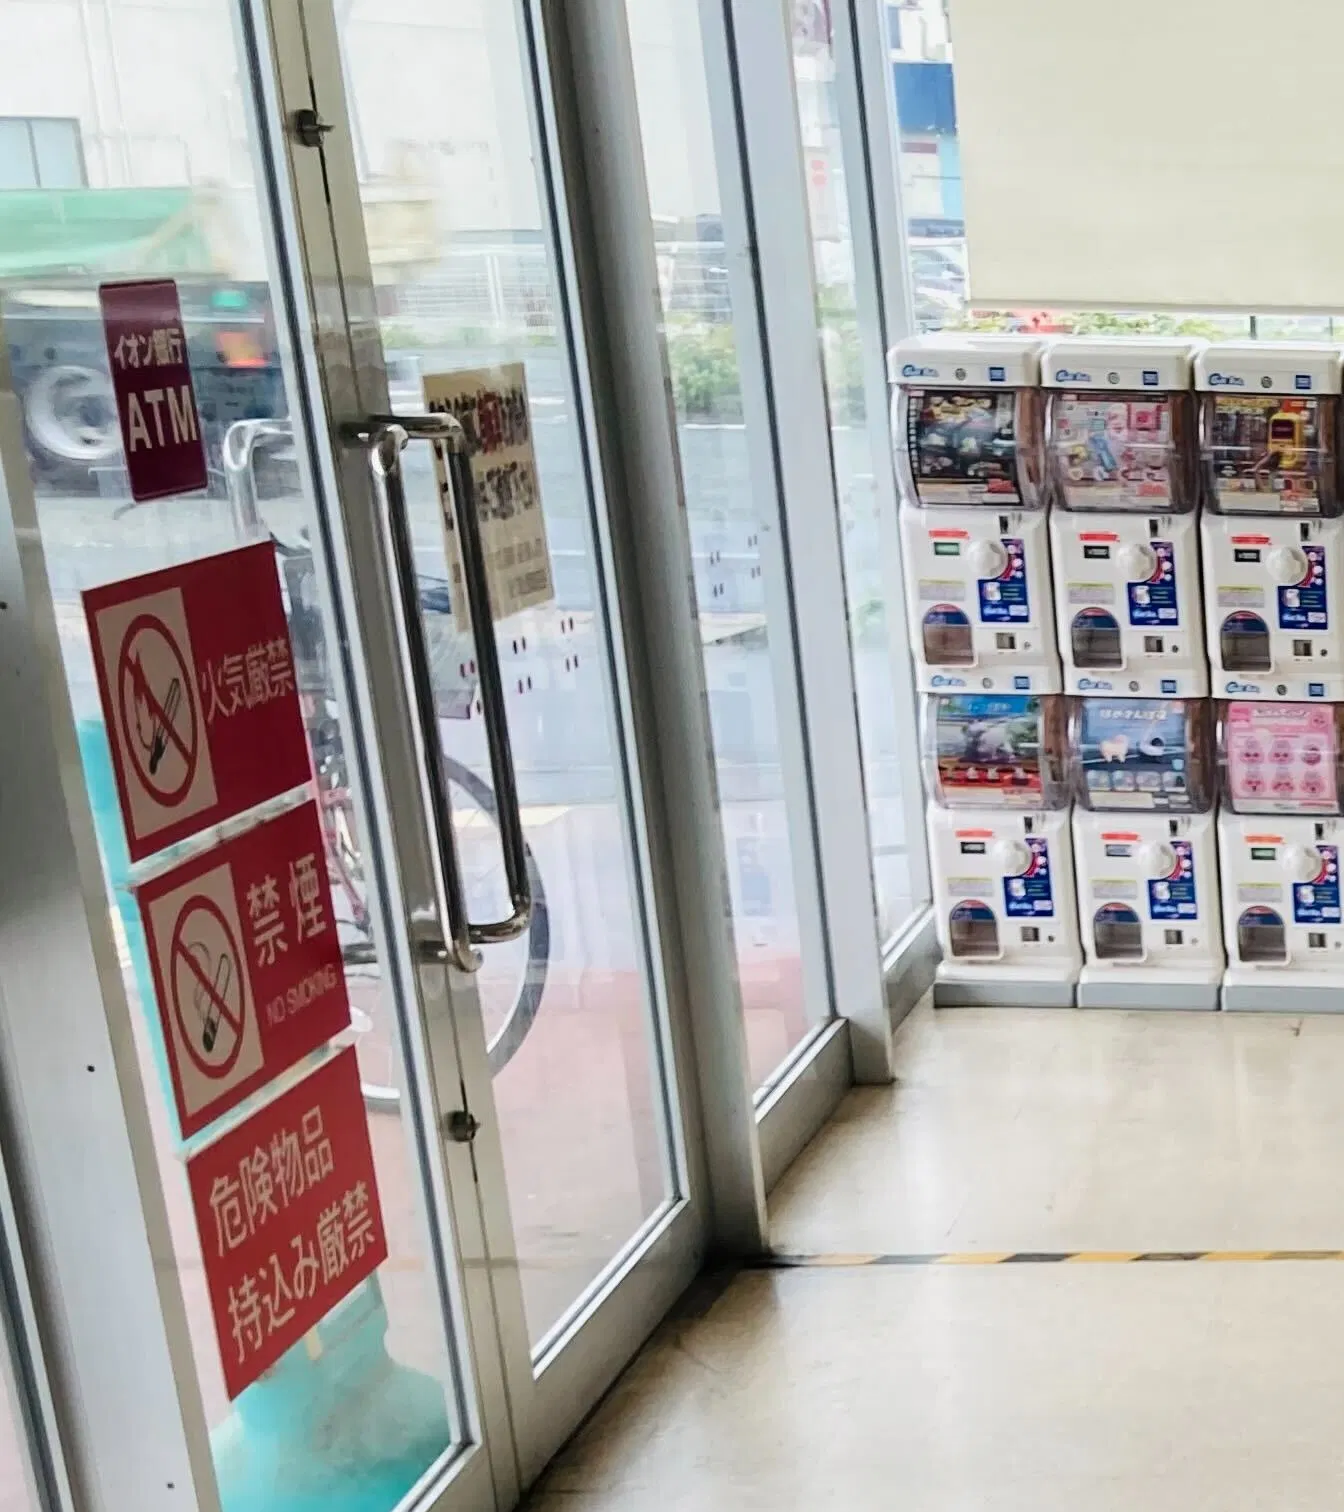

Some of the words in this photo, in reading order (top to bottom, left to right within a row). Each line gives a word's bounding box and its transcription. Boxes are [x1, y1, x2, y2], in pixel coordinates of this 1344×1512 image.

[114, 327, 184, 369] イオン銀行
[128, 384, 198, 452] ATM
[201, 636, 294, 725] 火気厳禁
[246, 853, 327, 968] 禁煙
[265, 997, 286, 1028] NO
[286, 963, 337, 1014] SMOKING
[209, 1104, 334, 1258] 危険物品
[228, 1180, 376, 1365] 持込み厳禁
